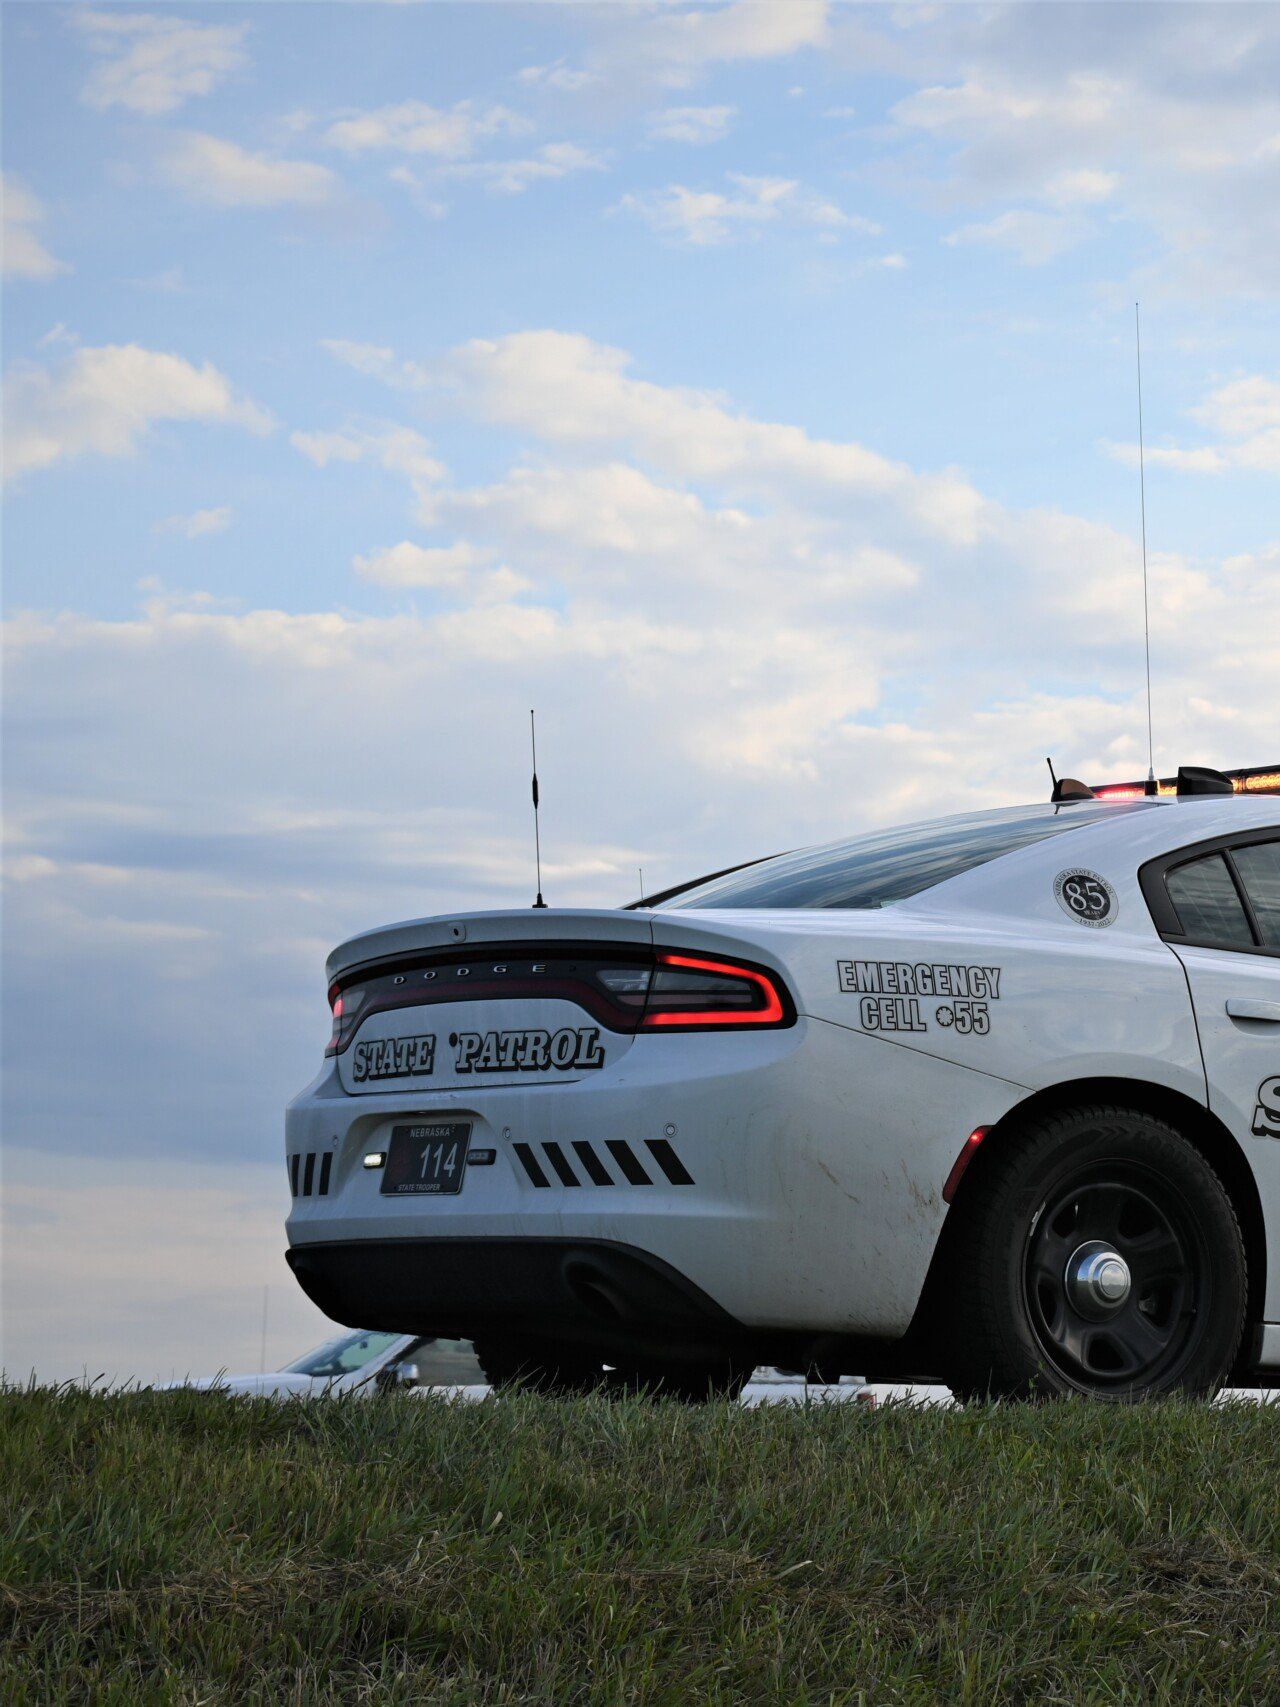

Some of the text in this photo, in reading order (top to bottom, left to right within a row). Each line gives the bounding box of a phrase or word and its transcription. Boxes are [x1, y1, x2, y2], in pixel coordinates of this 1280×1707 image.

[1065, 882, 1105, 910] 85
[393, 965, 546, 984] DODGE
[837, 960, 1000, 999] EMERGENCY
[860, 997, 926, 1031] CELL
[353, 1027, 605, 1082] STATE PATROL
[410, 1127, 450, 1138] NEBRASKA
[421, 1142, 457, 1178] 114
[415, 1183, 440, 1191] TROOPER
